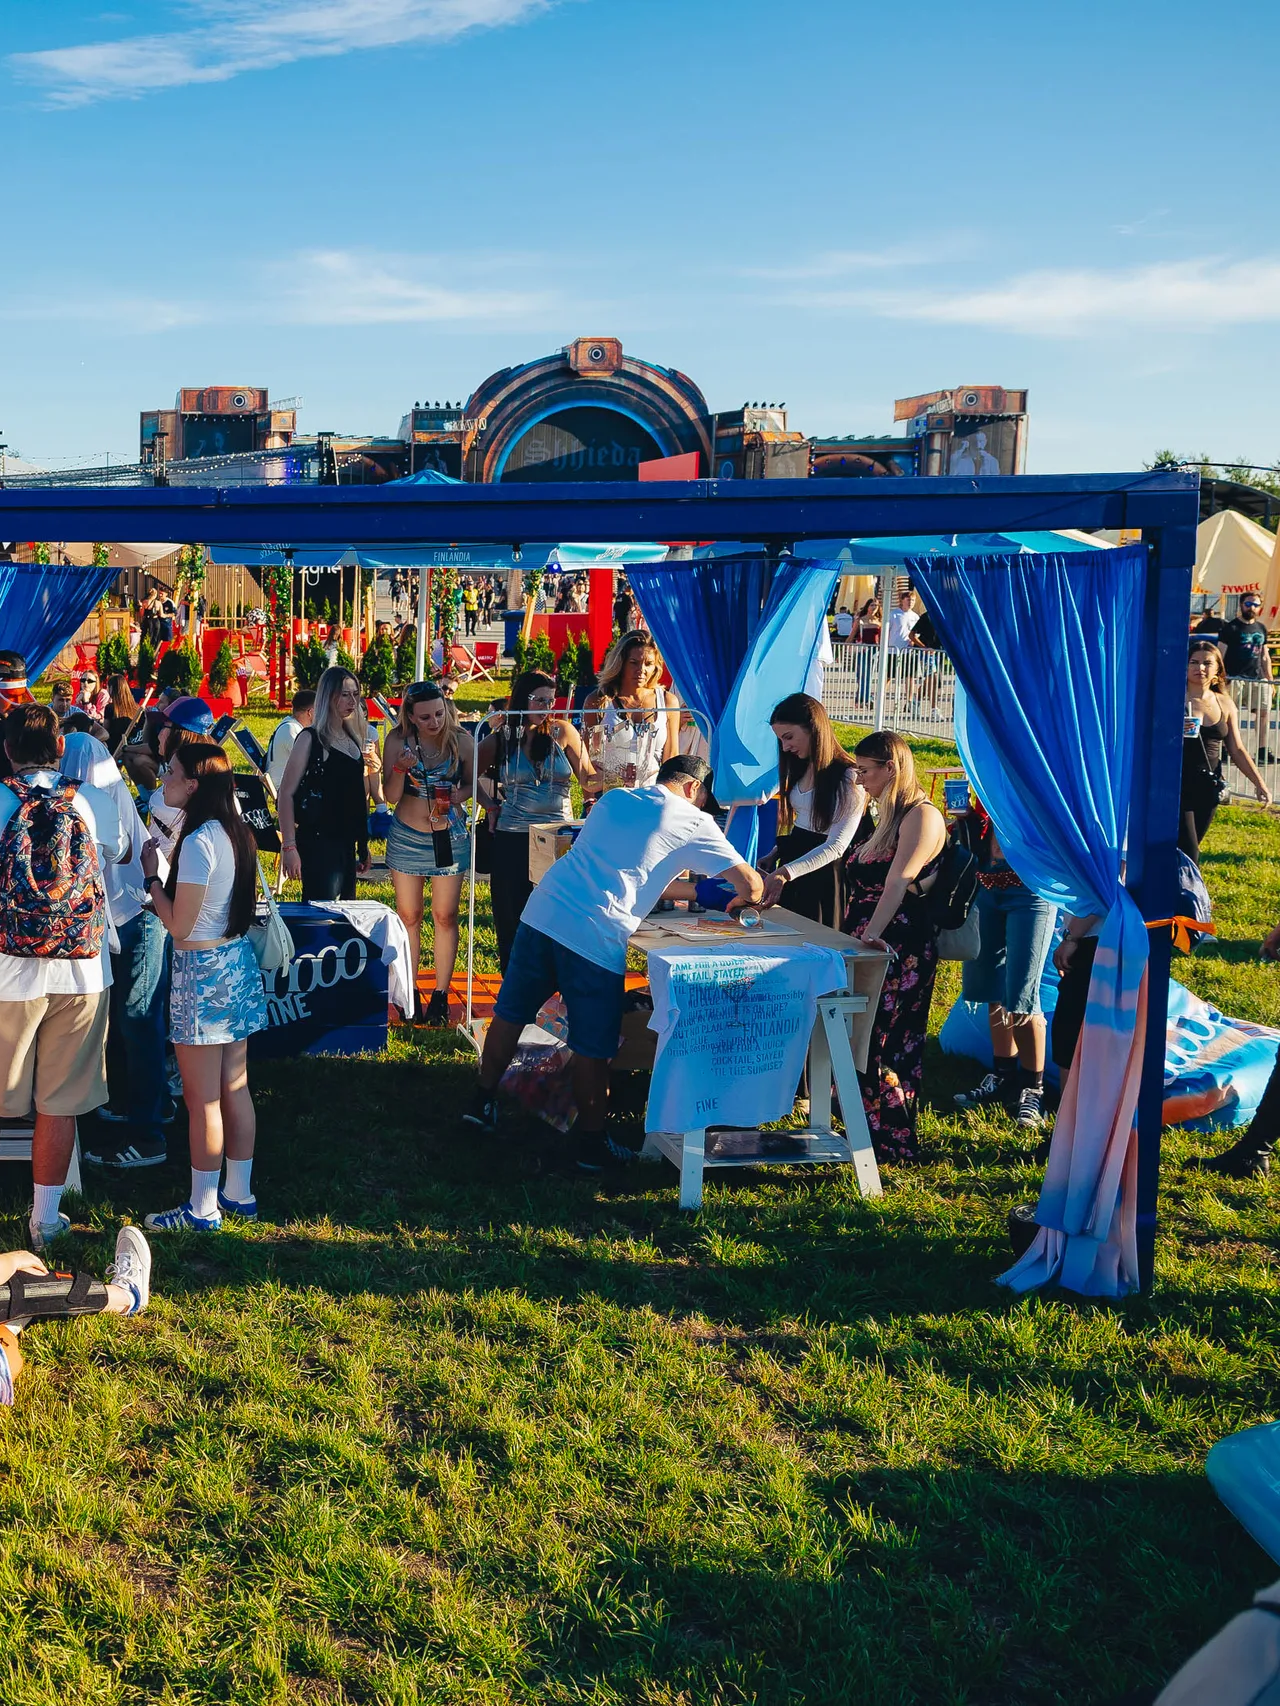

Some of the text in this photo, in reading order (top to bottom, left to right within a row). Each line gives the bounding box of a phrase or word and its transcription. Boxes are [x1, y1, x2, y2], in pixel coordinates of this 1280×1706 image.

[433, 551, 471, 562] FINLANDIA
[744, 1017, 800, 1038] FINLANDIA
[728, 1065, 746, 1076] THE
[696, 1097, 719, 1114] FINE
